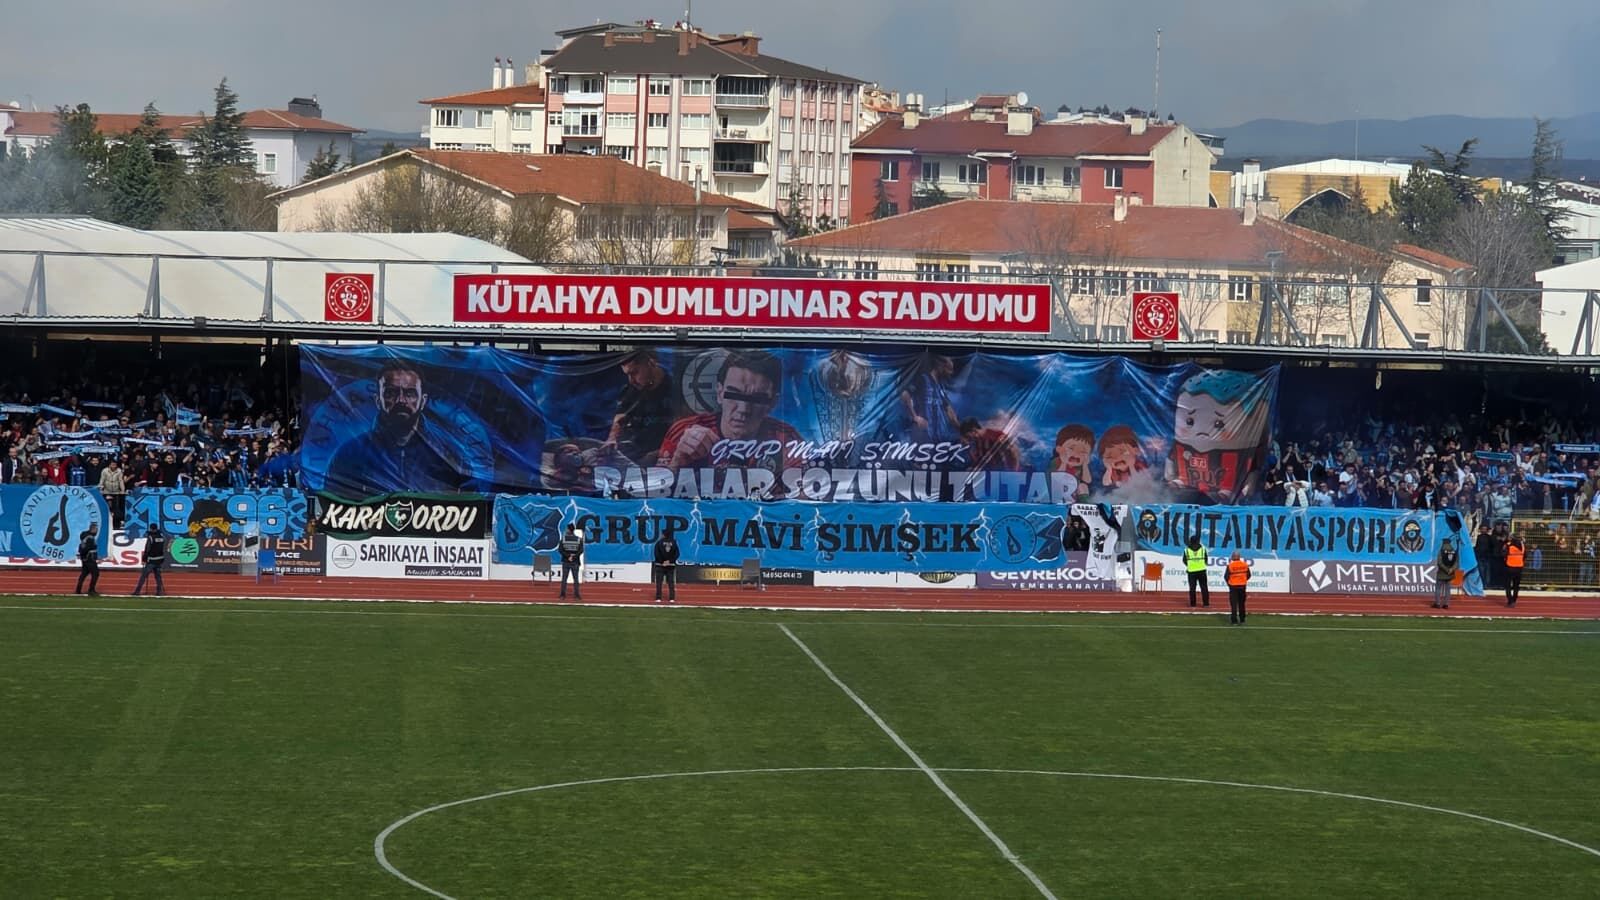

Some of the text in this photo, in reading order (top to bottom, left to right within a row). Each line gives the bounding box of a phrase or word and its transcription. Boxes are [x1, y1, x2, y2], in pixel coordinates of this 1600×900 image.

[467, 279, 1036, 323] KÜTAHYA DUMLUPINAR STADYUMU
[711, 438, 782, 465] GRUP
[781, 461, 942, 502] SÖZÜNÜ
[948, 471, 1078, 504] TUTAR
[323, 503, 478, 533] KARA ORDU
[575, 513, 981, 562] GRUP MAVİ ŞİMŞEK
[41, 545, 65, 560] 1966
[359, 543, 430, 563] SARIKAYA
[1336, 563, 1438, 584] METRIK
[1381, 584, 1437, 593] MÜHENDİSLİ
